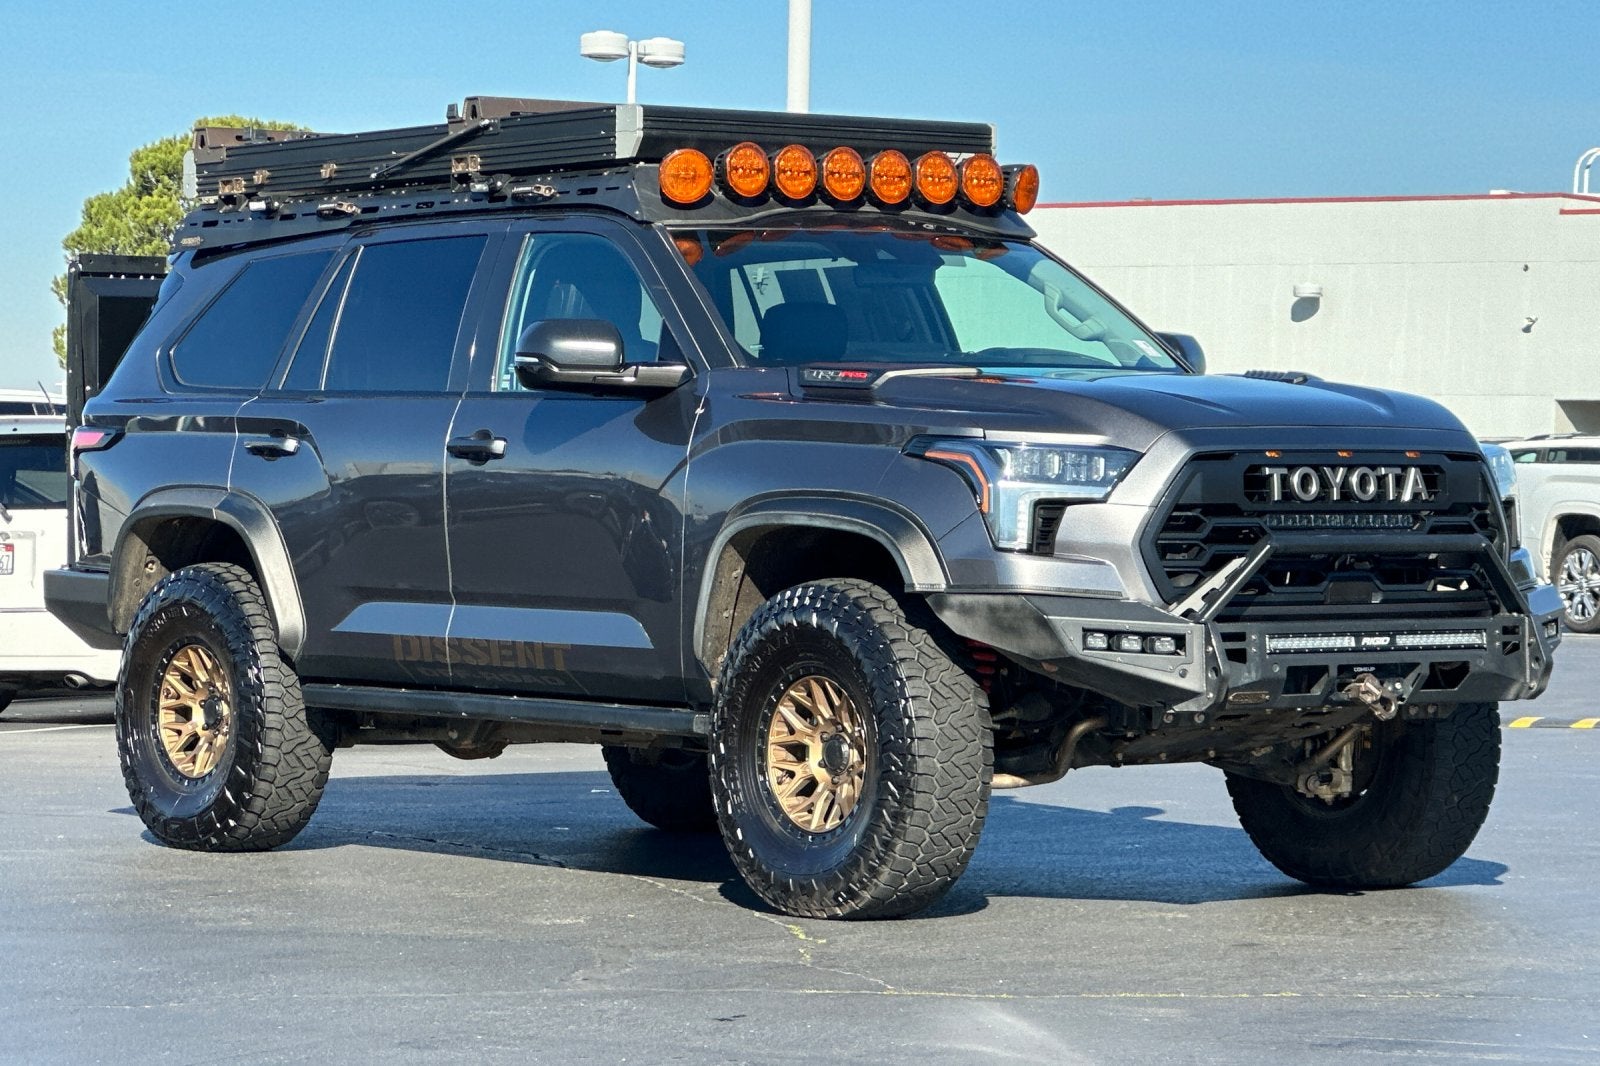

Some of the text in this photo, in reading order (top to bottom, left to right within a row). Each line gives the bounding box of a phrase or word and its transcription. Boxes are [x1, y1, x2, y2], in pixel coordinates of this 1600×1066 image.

[1265, 466, 1431, 502] TOYOTA
[393, 634, 571, 671] DISSENT
[1361, 636, 1391, 646] RIGID
